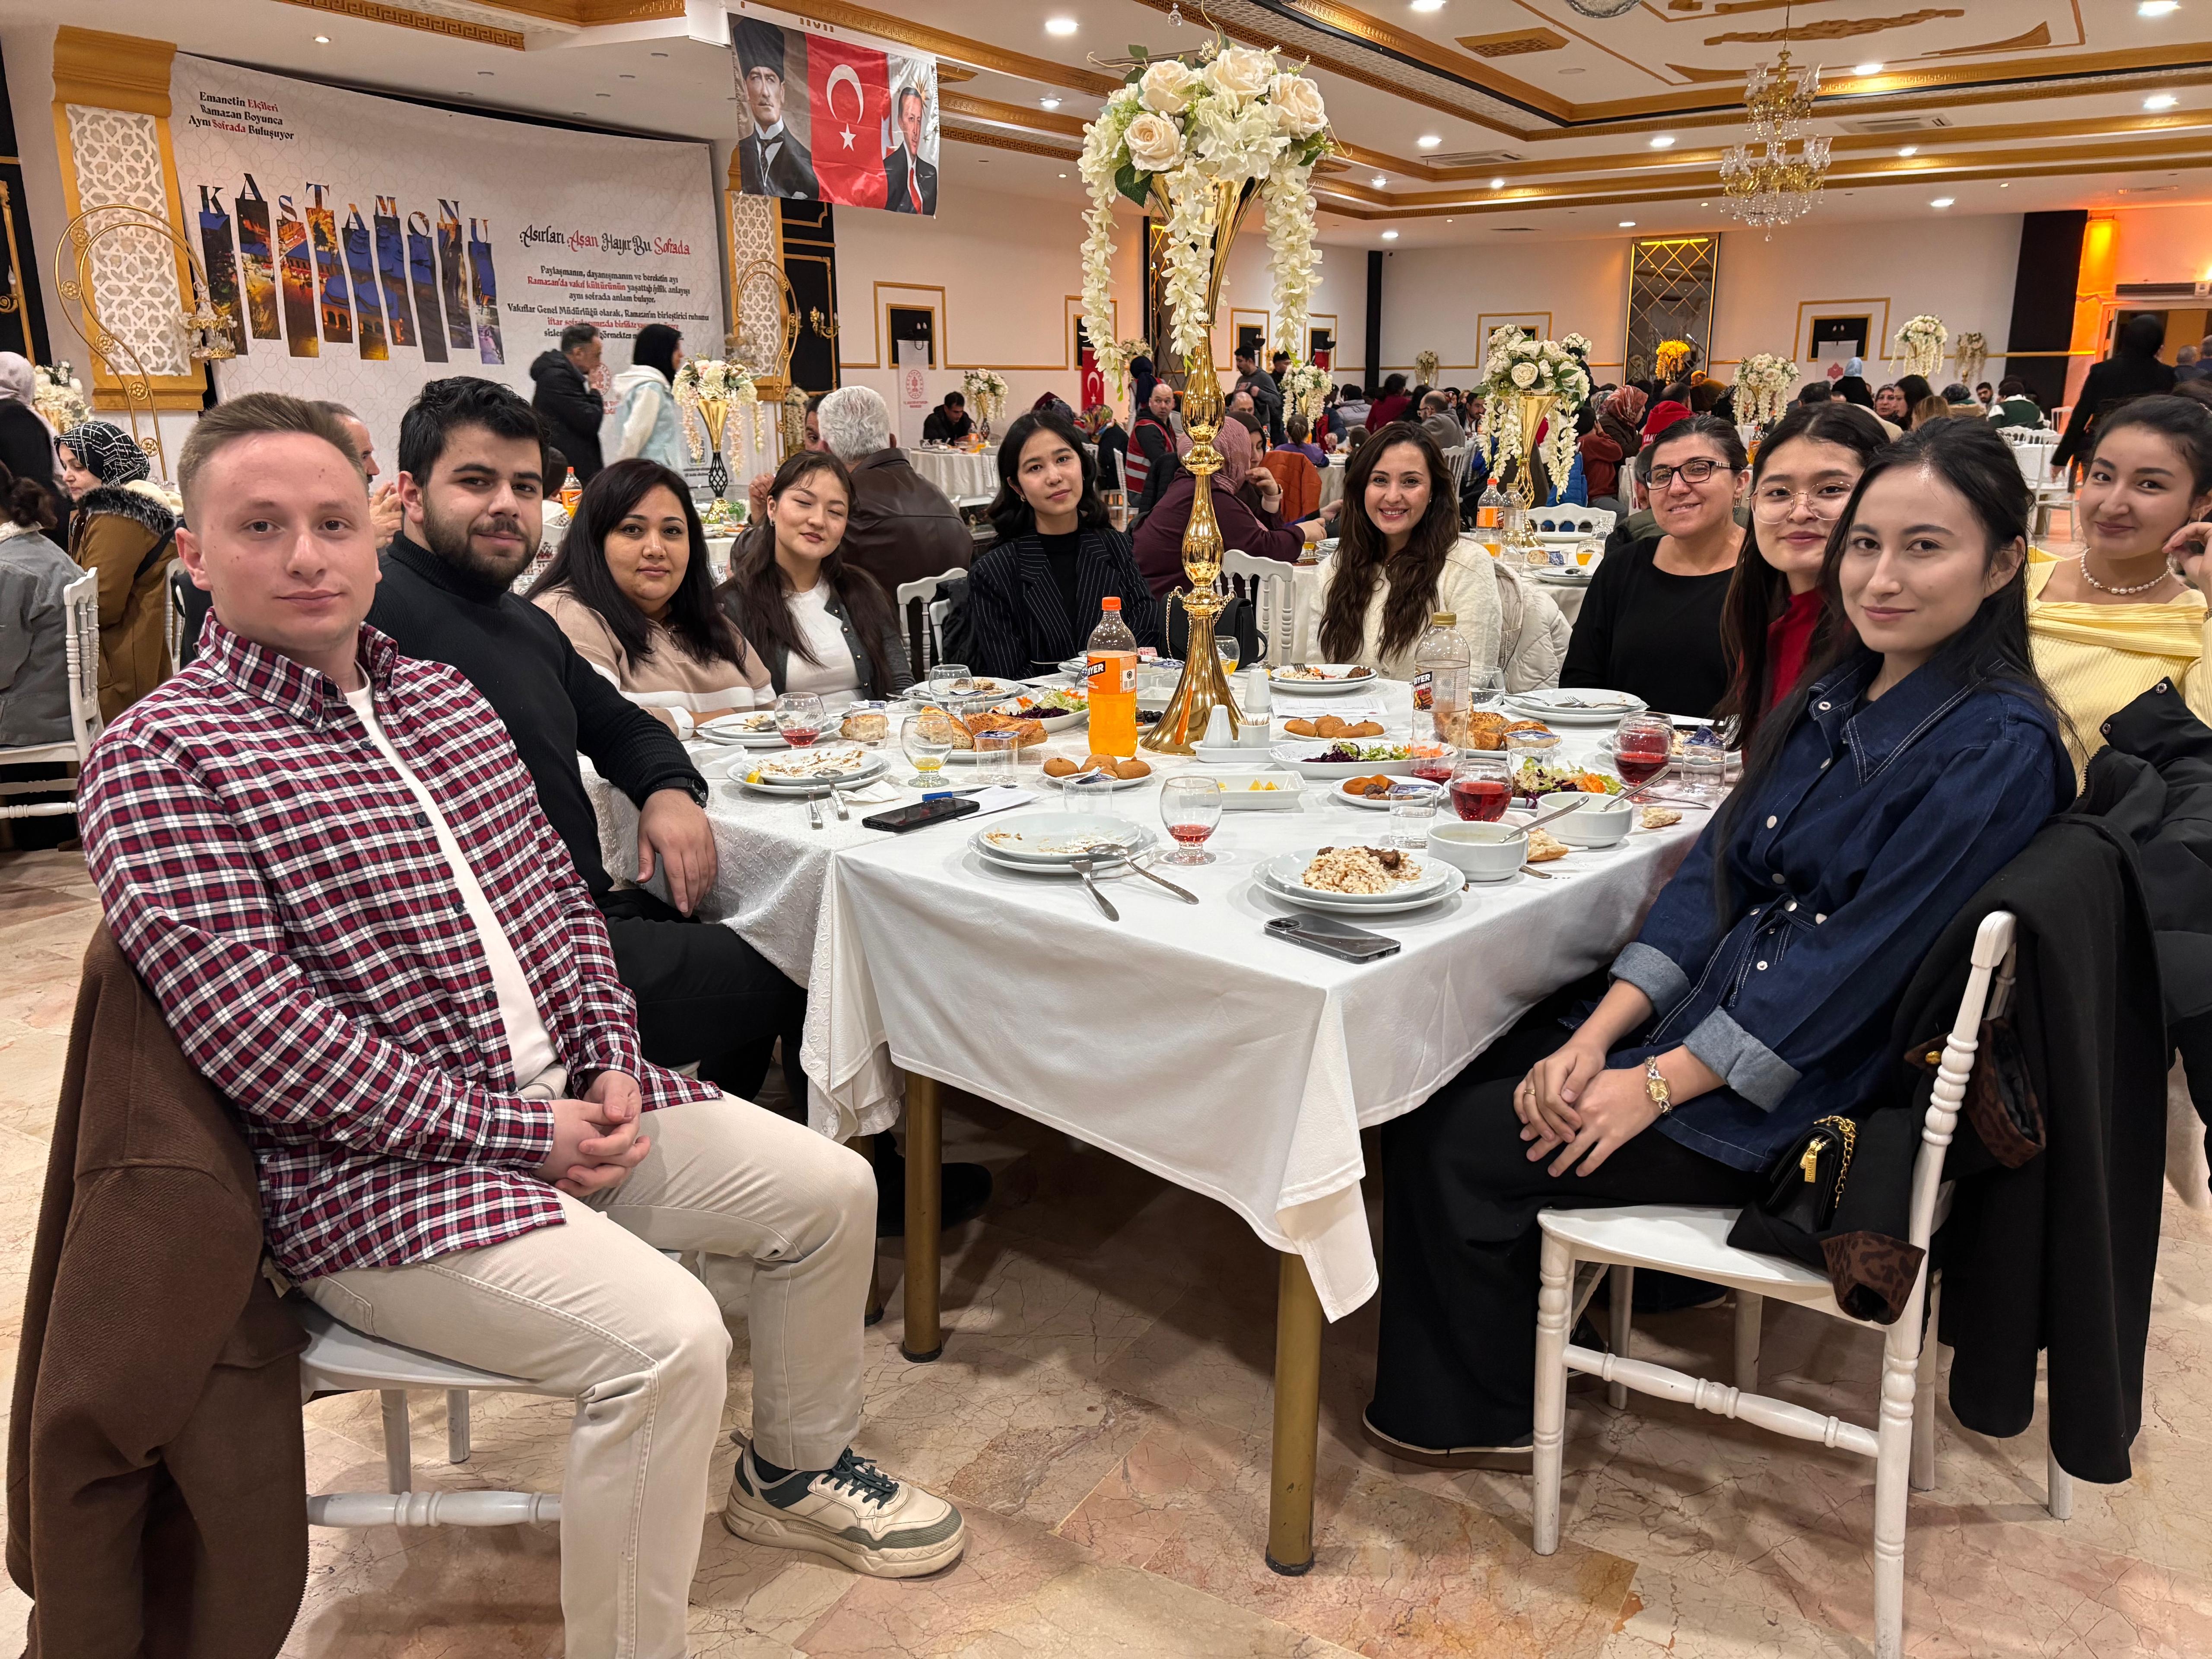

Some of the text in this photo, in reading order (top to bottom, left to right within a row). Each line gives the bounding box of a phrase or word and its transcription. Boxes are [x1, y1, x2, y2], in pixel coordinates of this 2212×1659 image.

[200, 91, 279, 112] Emanetin Elçileri
[200, 104, 283, 125] Ramazan Boyunca
[189, 115, 294, 140] Aynı Sofrada Buluşuyor
[197, 173, 488, 243] KASTAMONU
[520, 225, 691, 255] Asırları Aşan Hayır Bu Sofrada
[540, 265, 585, 278] Paylaşmanın,
[587, 270, 633, 281] dayanışmanın
[643, 273, 667, 282] bereketin
[569, 280, 585, 288] vakıf
[586, 280, 626, 291] kültürünün
[585, 292, 610, 301] sofrada
[507, 303, 535, 313] Vakıflar
[537, 305, 558, 314] Genel
[559, 306, 598, 318] Müdürlüğü
[547, 317, 563, 326] iftar
